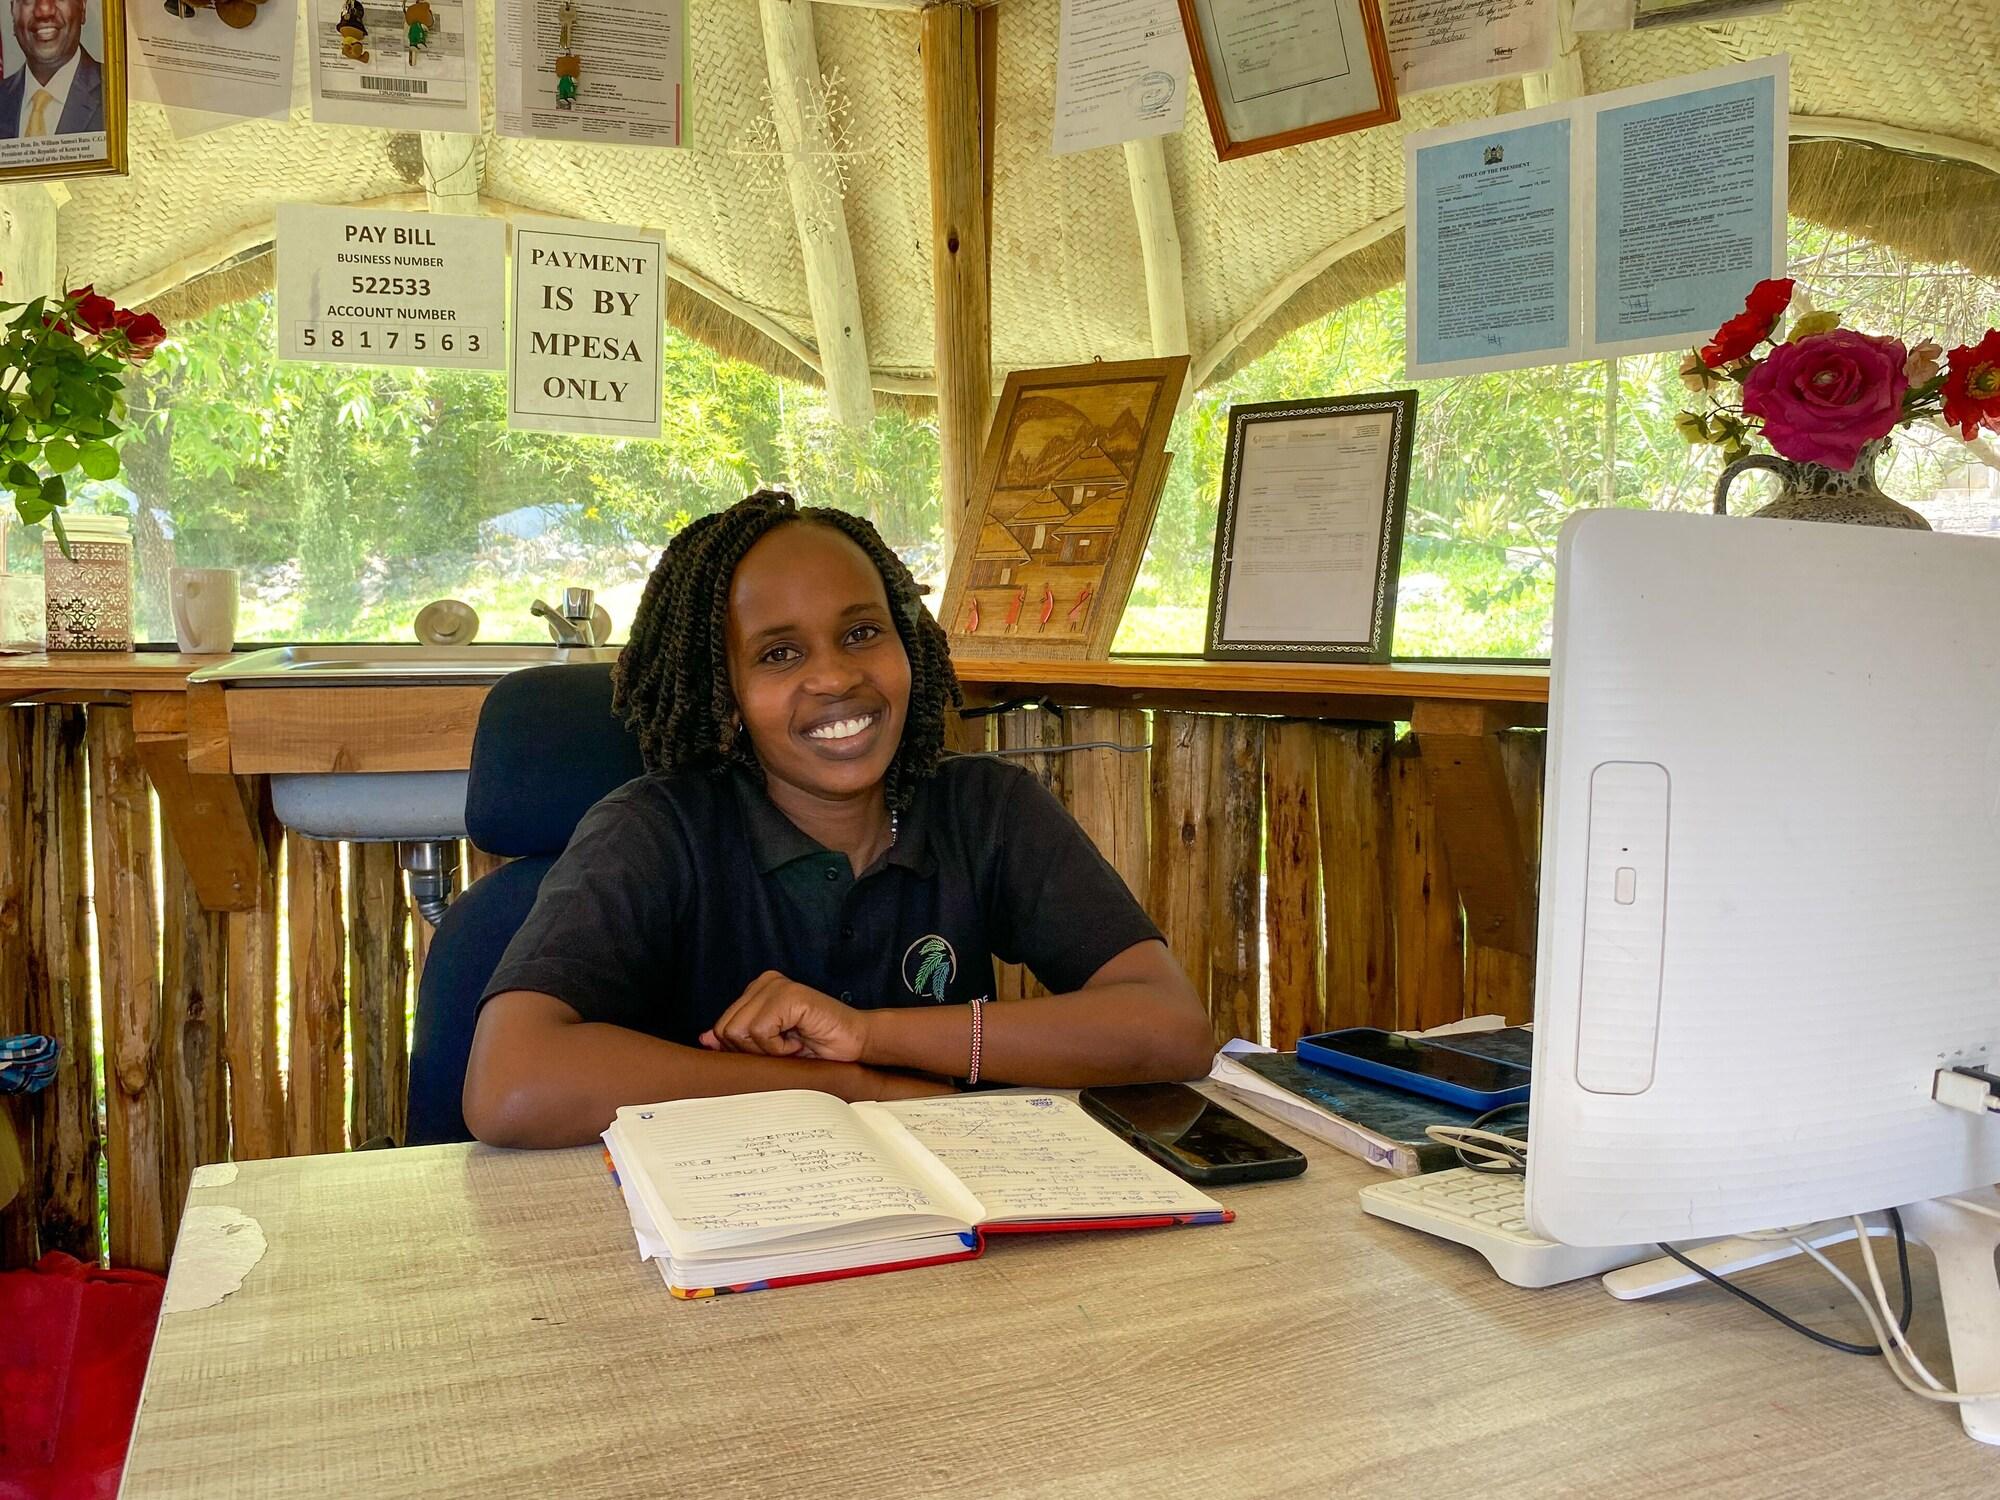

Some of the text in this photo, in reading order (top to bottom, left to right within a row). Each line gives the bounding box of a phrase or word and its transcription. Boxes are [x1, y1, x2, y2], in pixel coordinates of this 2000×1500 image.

[345, 225, 436, 246] PAY BILL
[337, 253, 444, 267] BUSINESS NUMBER
[531, 248, 647, 275] PAYMENT
[352, 276, 431, 296] 522533
[327, 305, 456, 321] ACCOUNT NUMBER
[542, 285, 641, 317] IS BY
[529, 331, 643, 363] MPESA
[543, 376, 629, 403] ONLY
